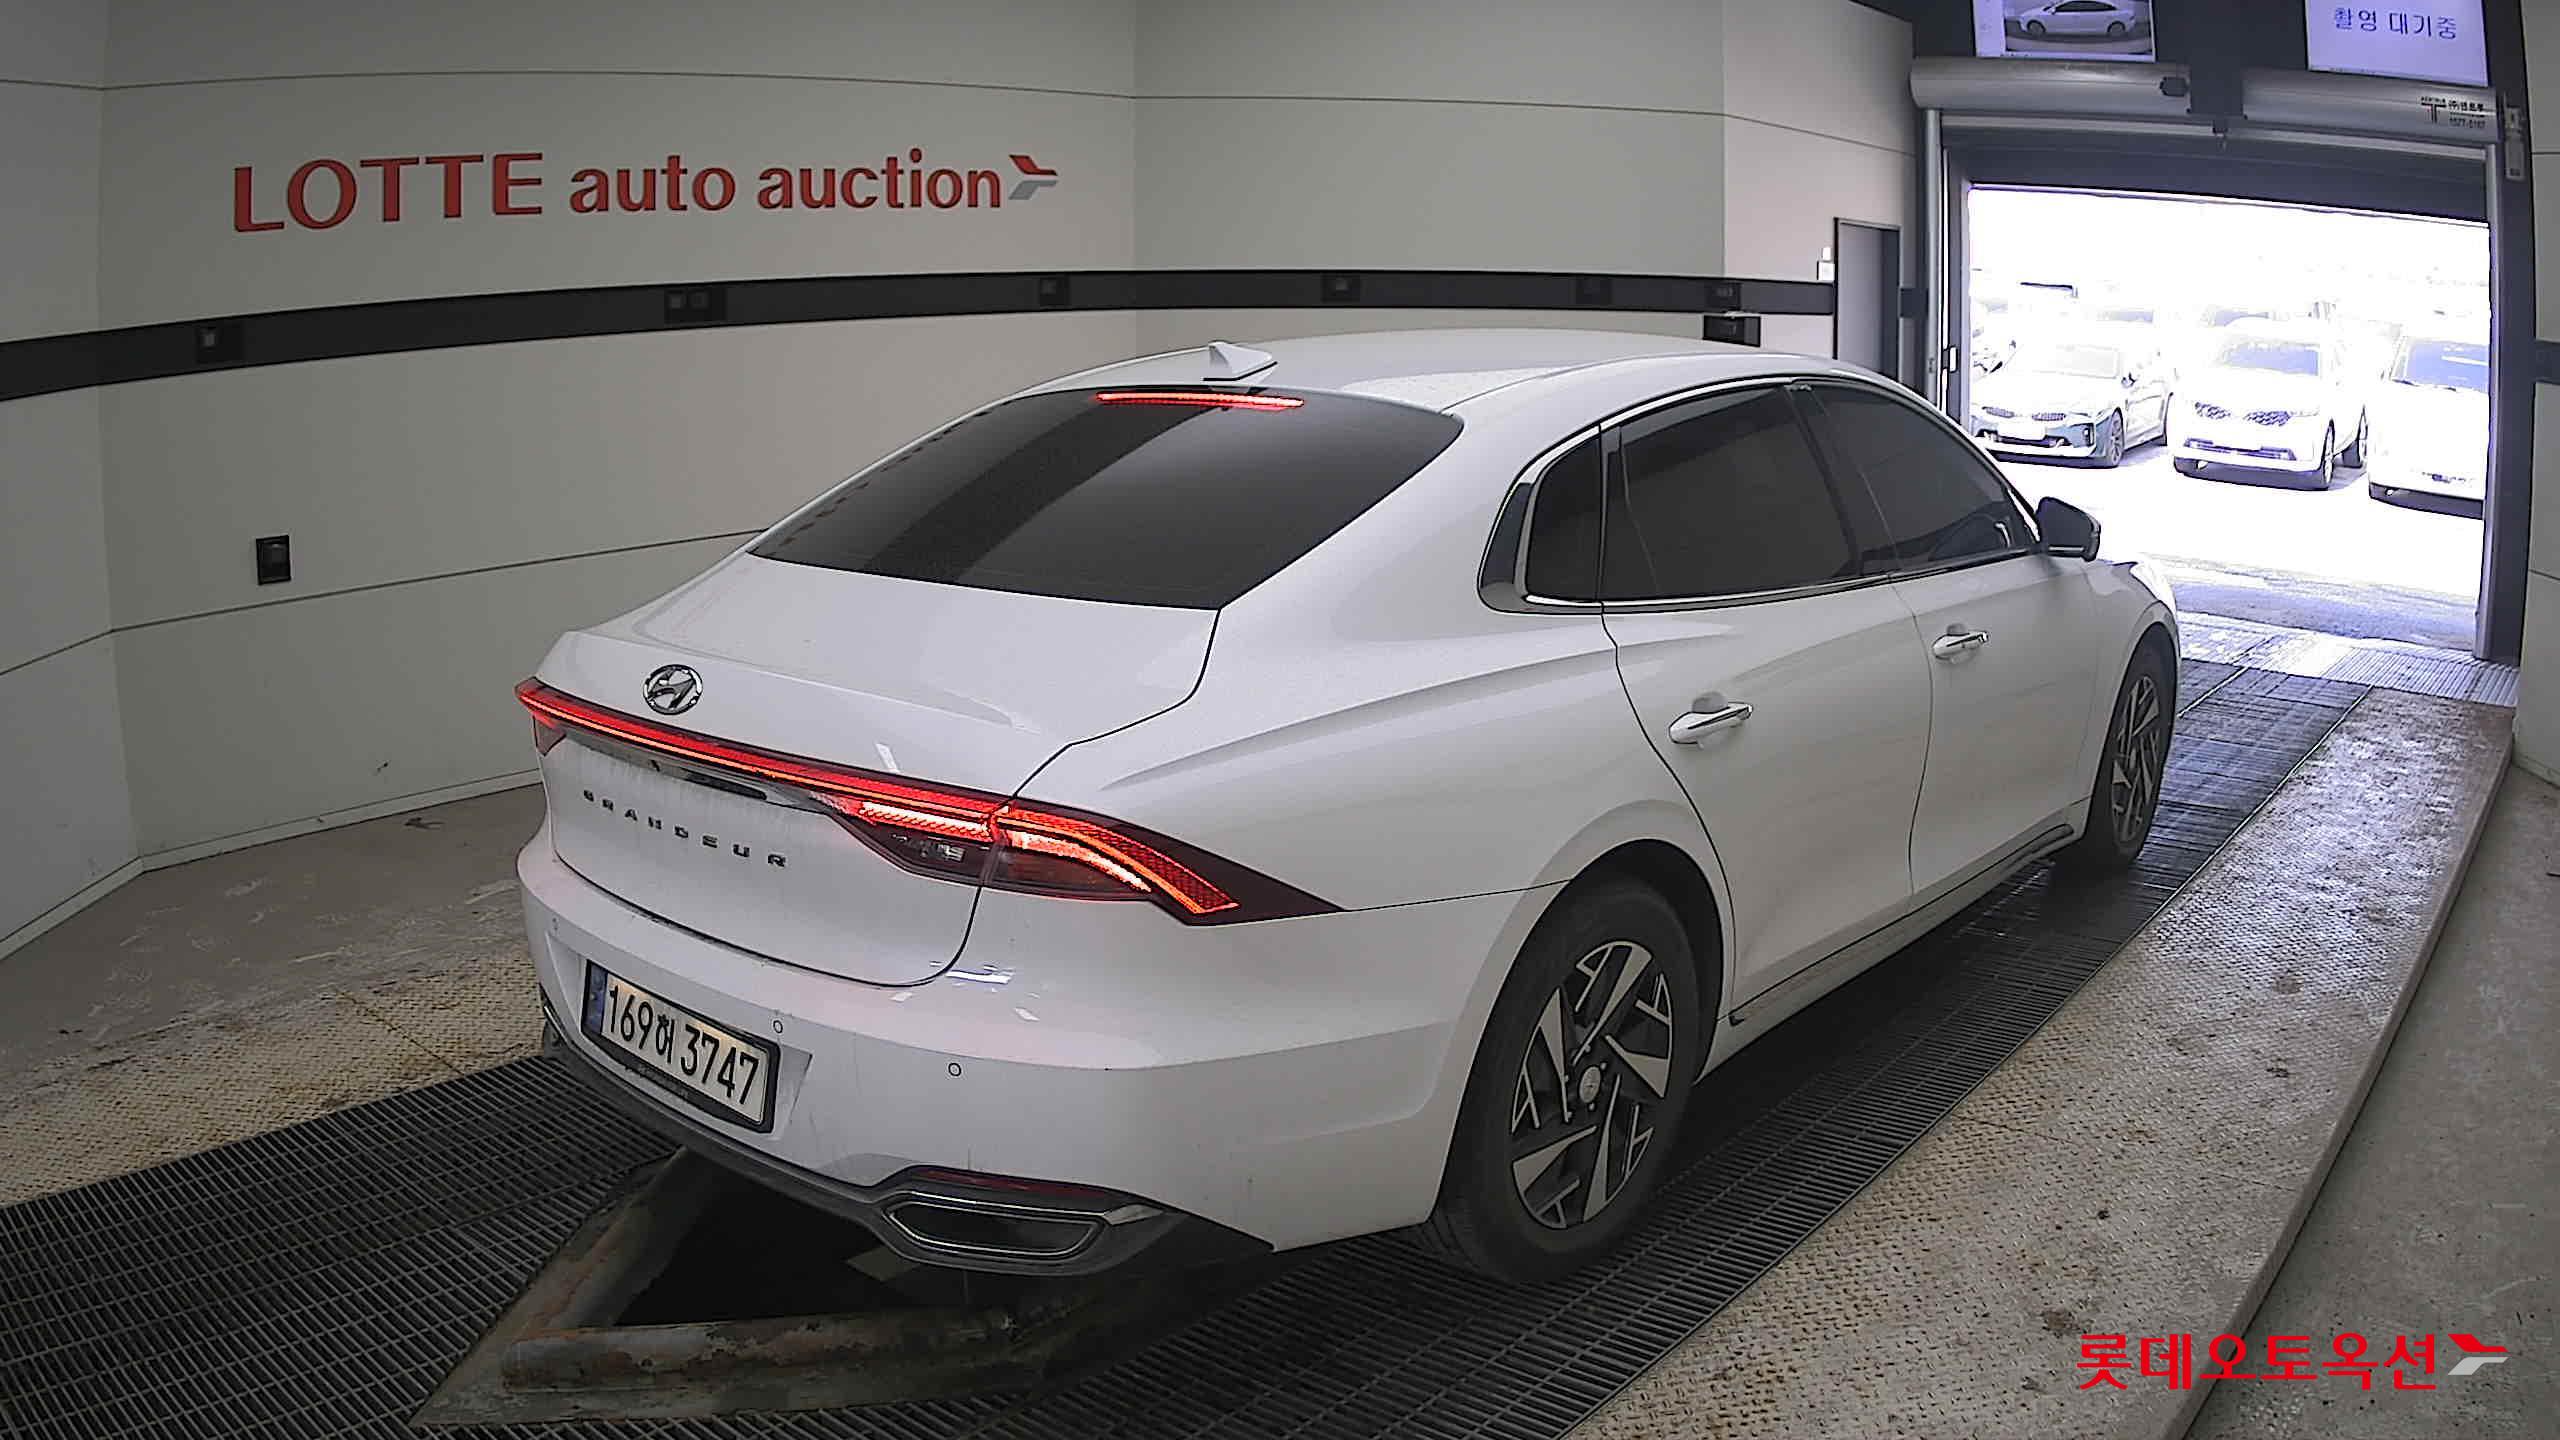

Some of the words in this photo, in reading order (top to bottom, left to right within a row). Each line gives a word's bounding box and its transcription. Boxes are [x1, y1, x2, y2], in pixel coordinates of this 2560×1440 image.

[2335, 7, 2377, 32] 촬영
[2388, 12, 2457, 40] 대기중
[234, 152, 543, 233] LOTTE
[569, 154, 736, 213] auto
[757, 148, 1002, 209] auction
[583, 789, 786, 868] GRANDEUR
[609, 985, 675, 1064] 169허
[680, 1023, 759, 1105] 3747
